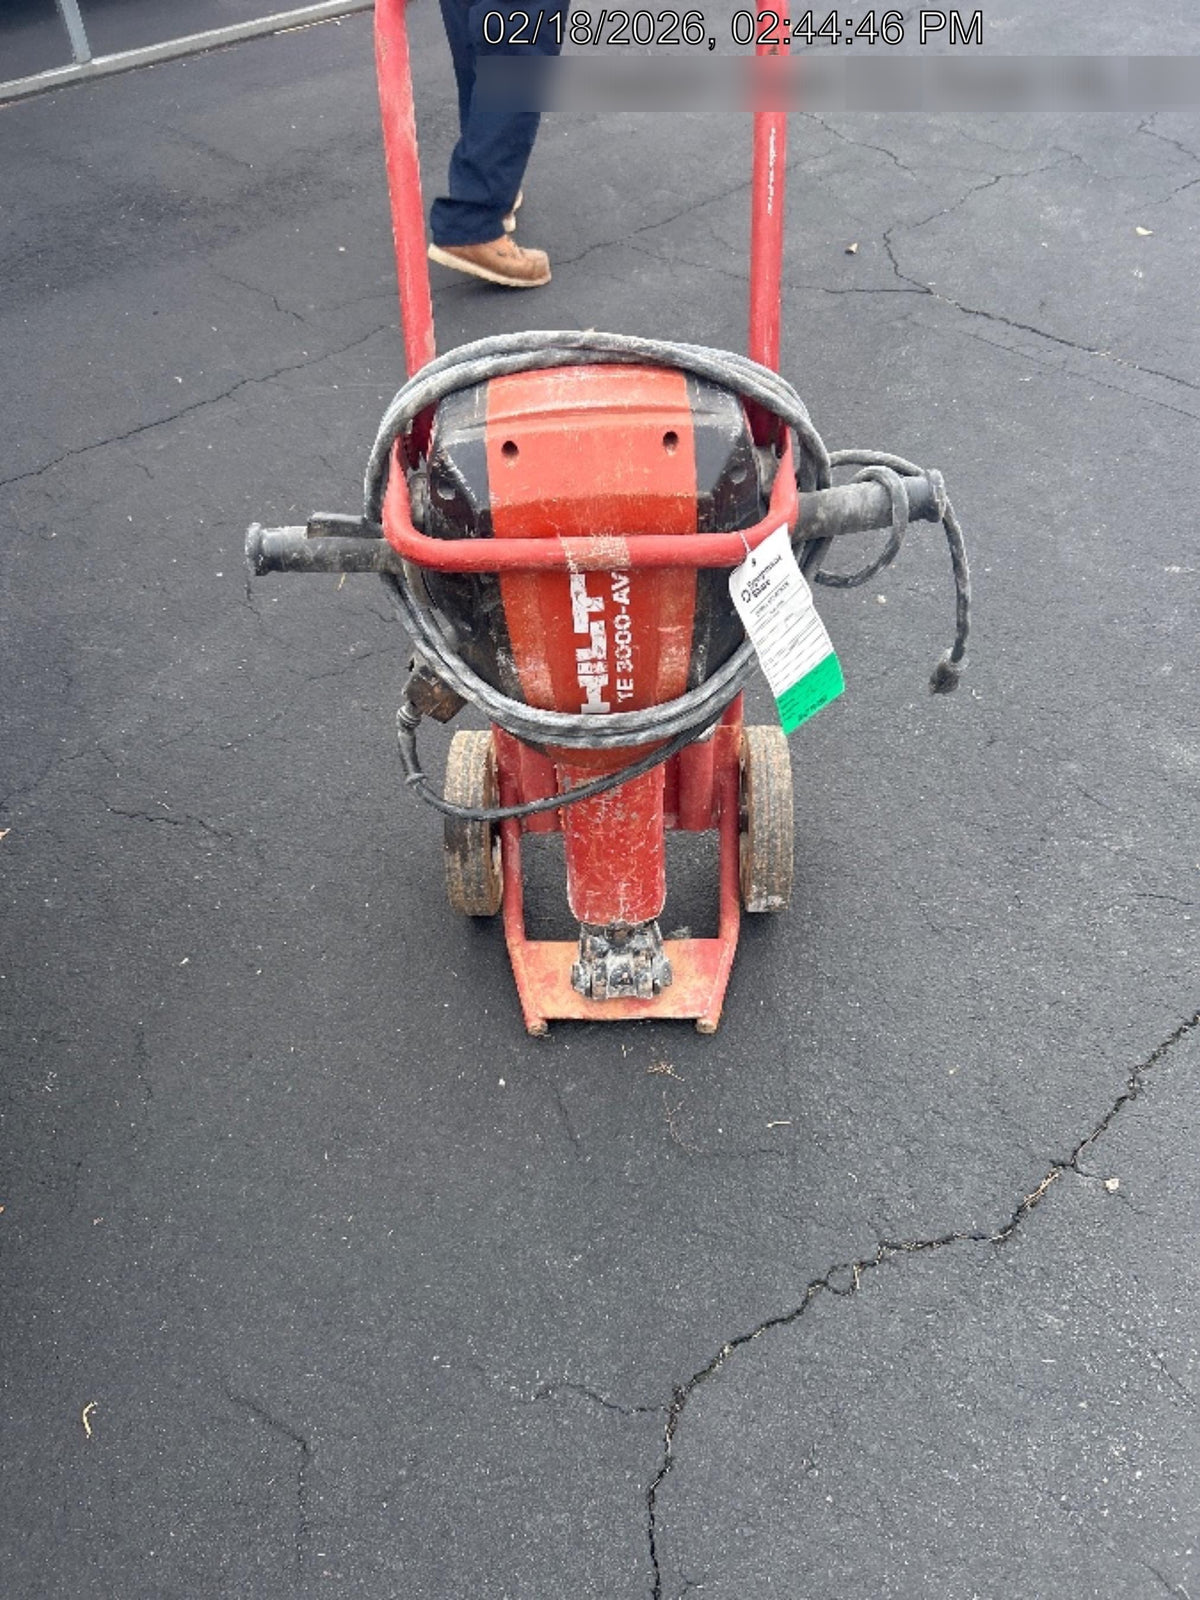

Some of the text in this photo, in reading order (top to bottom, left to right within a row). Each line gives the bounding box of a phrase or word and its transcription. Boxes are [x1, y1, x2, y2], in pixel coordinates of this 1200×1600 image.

[569, 572, 611, 714] HILT
[611, 569, 634, 703] TE 3000-AV
